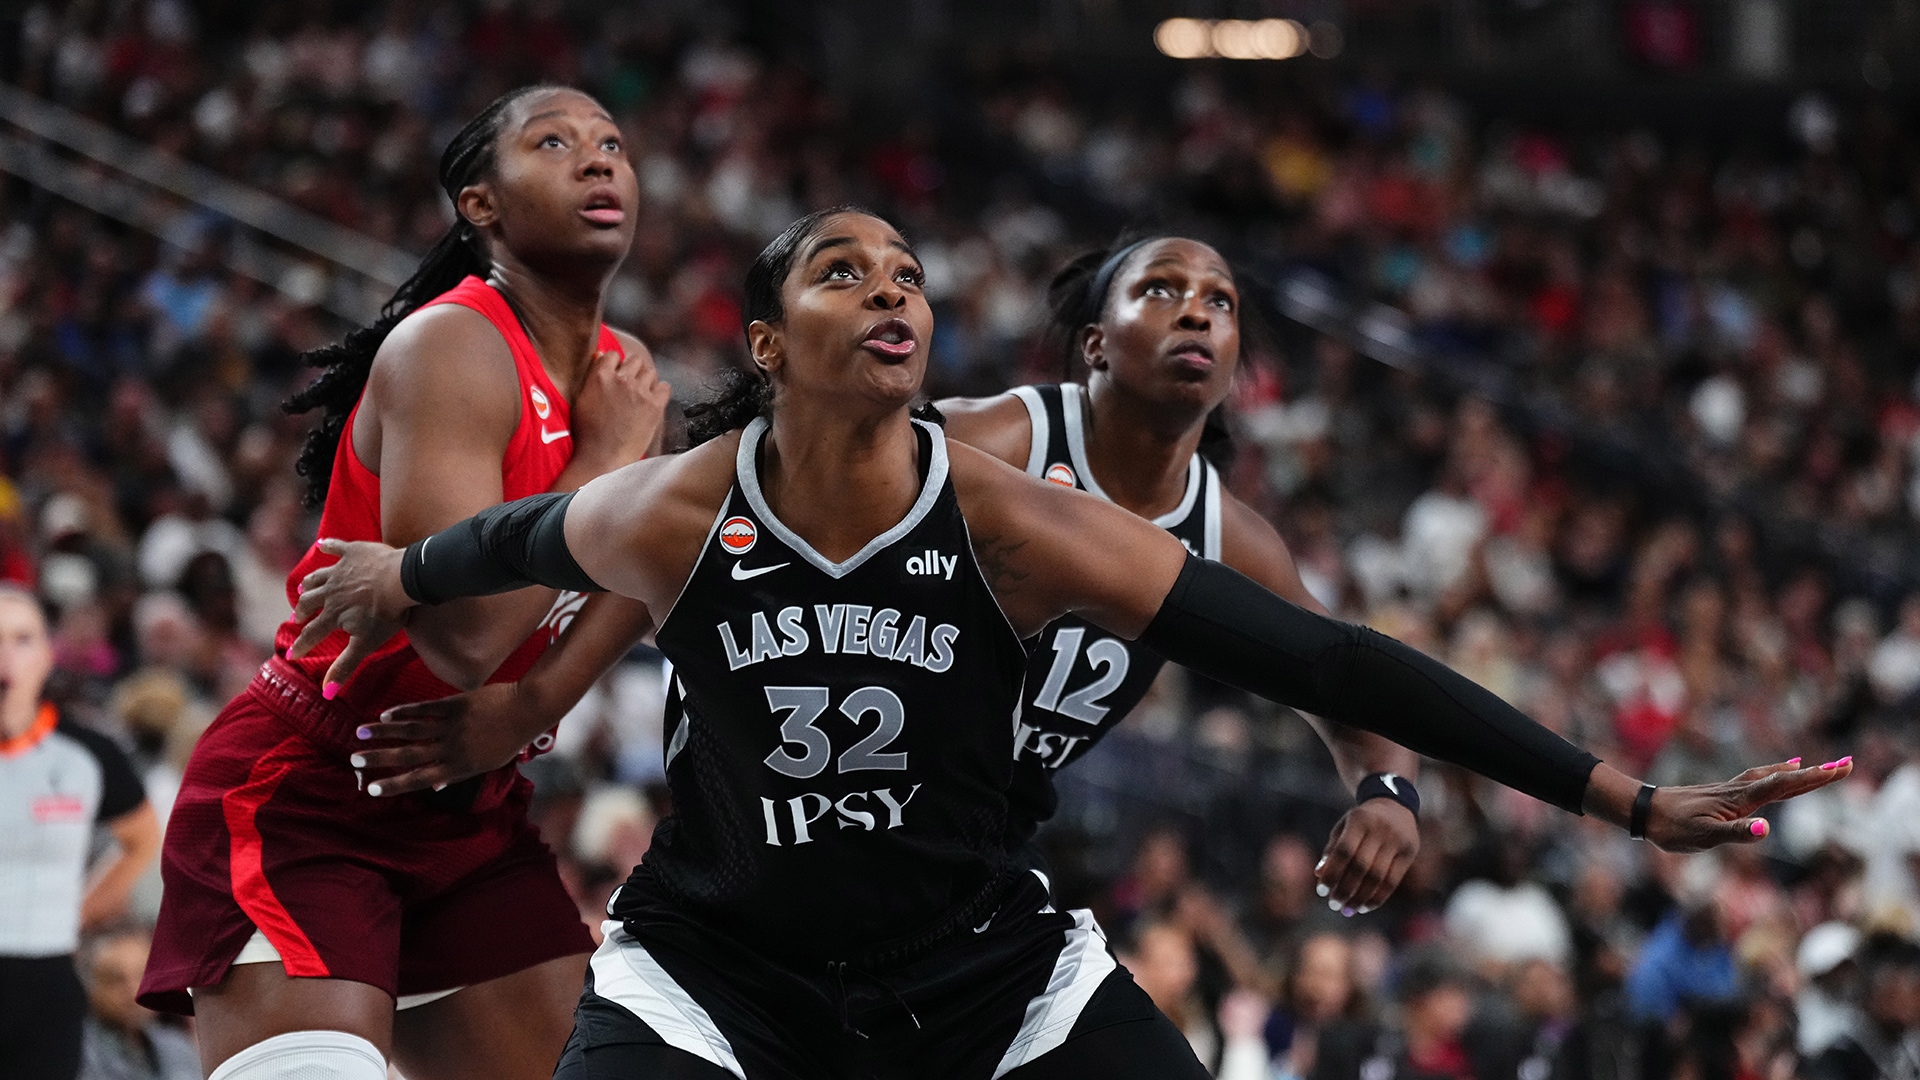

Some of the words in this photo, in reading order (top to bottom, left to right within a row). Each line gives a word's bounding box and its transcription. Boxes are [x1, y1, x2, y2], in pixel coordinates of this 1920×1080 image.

[905, 549, 957, 580] ally
[717, 607, 809, 671] LAS
[814, 604, 960, 673] VEGAS
[1033, 626, 1130, 726] 12
[763, 686, 908, 779] 32
[760, 782, 922, 847] IPSY
